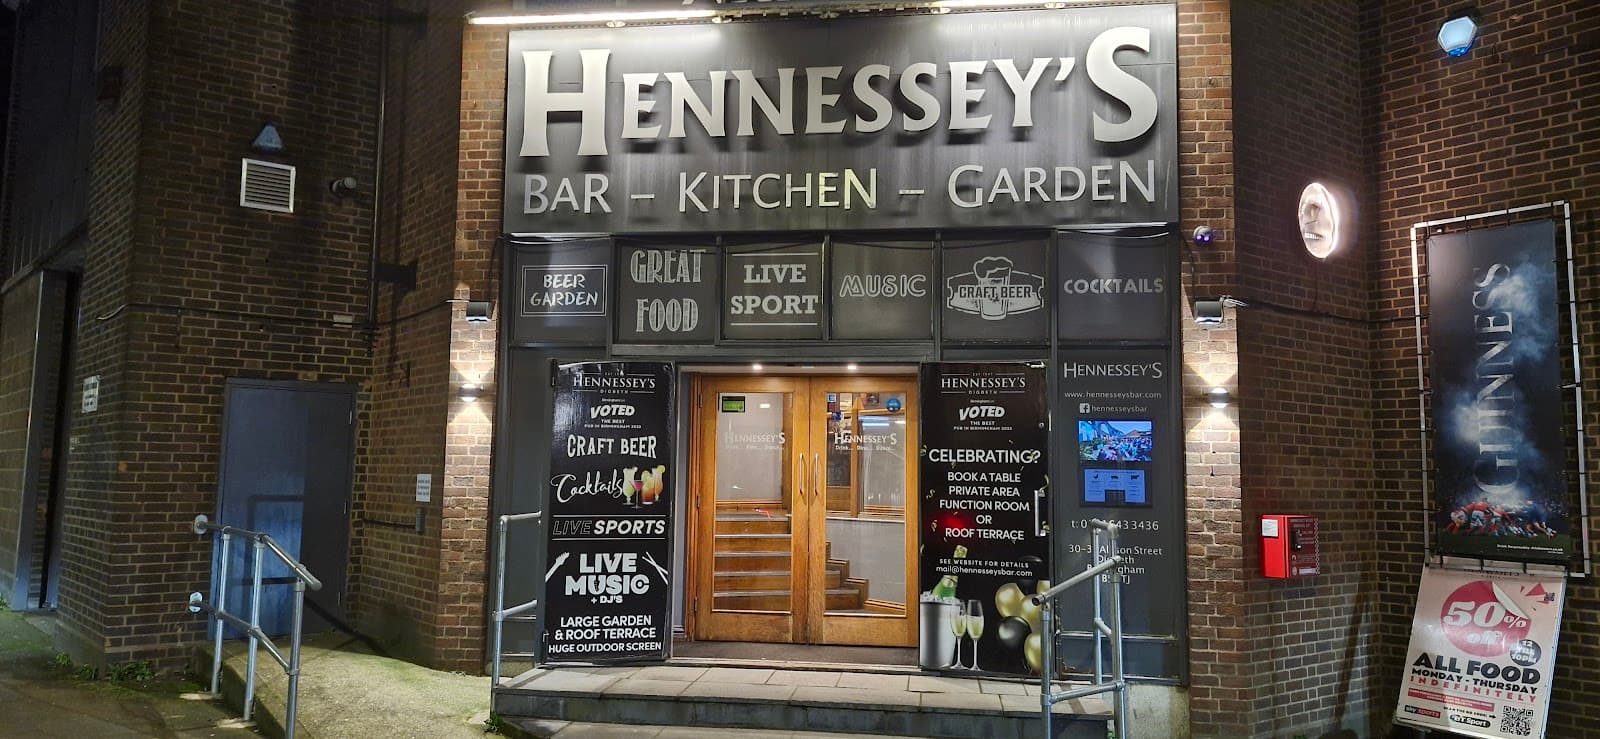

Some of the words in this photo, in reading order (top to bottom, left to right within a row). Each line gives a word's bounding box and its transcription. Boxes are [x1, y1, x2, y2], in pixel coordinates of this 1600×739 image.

[519, 26, 1158, 158] HENNESSEY'S
[523, 173, 612, 214] BAR
[679, 168, 878, 213] KITCHEN
[949, 160, 1156, 208] GARDEN
[630, 249, 706, 284] GREAT
[743, 264, 807, 284] LIVE
[543, 273, 586, 289] BEER
[840, 274, 927, 298] MUSIC
[1063, 277, 1164, 294] COCKTAILS
[530, 291, 599, 307] GARDEN
[958, 286, 998, 299] CRAFT
[1002, 286, 1032, 299] BEER
[730, 295, 819, 315] SPORT
[635, 298, 699, 333] FOOD
[1063, 362, 1163, 379] HENNESSEY'S
[1472, 262, 1520, 495] GUINNESS
[573, 375, 656, 389] HENNESSEY'S
[941, 377, 1026, 389] HENNESSEY'S
[1064, 390, 1162, 400] www.hennesseysbar.com
[590, 404, 636, 419] VOTED
[959, 405, 1006, 421] VOTED
[1091, 404, 1148, 414] hennesseysbar
[567, 434, 615, 458] CRAFT
[620, 435, 657, 459] BEER
[834, 432, 898, 445] HENNESSEY'S
[928, 449, 1041, 464] CELEBRATING?
[947, 471, 979, 482] BOOK
[979, 473, 988, 482] A
[989, 472, 1022, 483] TABLE
[550, 468, 624, 503] Cocktails
[948, 485, 991, 496] PRIVATE
[991, 487, 1020, 497] AREA
[939, 500, 993, 511] FUNCTION
[994, 501, 1030, 511] ROOM
[552, 520, 593, 535] LIVE
[593, 520, 666, 535] SPORTS
[976, 515, 992, 525] OR
[945, 528, 975, 538] ROOF
[976, 529, 1025, 540] TERRACE
[1133, 545, 1162, 555] Street
[579, 553, 638, 573] LIVE
[935, 565, 1033, 577] mail@hennesseysbar.com
[565, 574, 650, 595] MUSIC
[599, 595, 623, 604] DJ'S
[560, 616, 600, 628] LARGE
[601, 615, 652, 627] GARDEN
[1442, 600, 1527, 628] 50%
[554, 629, 563, 640] &
[565, 629, 601, 640] ROOF
[601, 627, 657, 639] TERRACE
[1466, 630, 1503, 646] off
[548, 644, 575, 653] HUGE
[576, 643, 625, 653] OUTDOOR
[626, 642, 662, 651] SCREEN
[1413, 652, 1461, 674] ALL
[1467, 659, 1541, 685] FOOD
[1410, 675, 1537, 703] INDEFINITELY
[1411, 667, 1463, 683] MONDAY
[1473, 677, 1538, 695] THURSDAY
[1466, 717, 1487, 727] Sport
